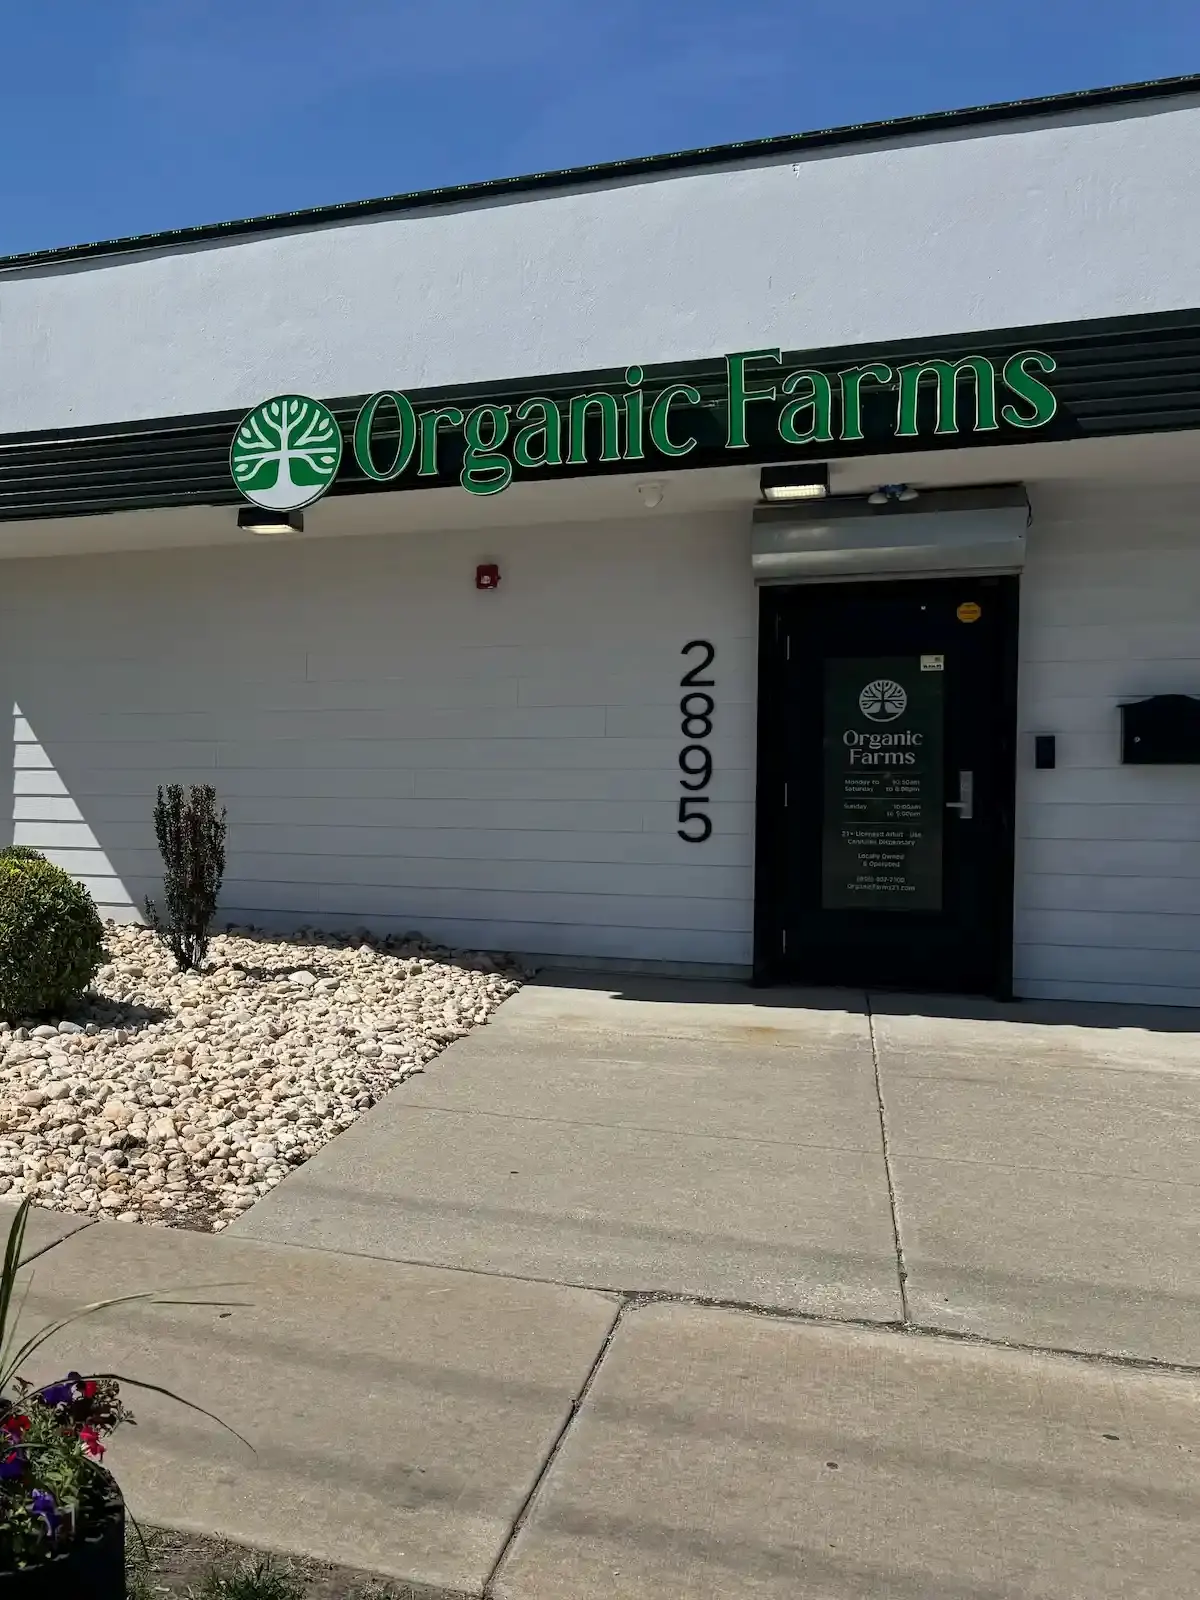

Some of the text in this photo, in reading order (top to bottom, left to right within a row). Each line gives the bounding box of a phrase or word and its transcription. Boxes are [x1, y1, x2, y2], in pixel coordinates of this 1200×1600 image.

[352, 346, 1059, 496] Organic Farms
[677, 639, 716, 843] 2895
[842, 729, 923, 750] Organic
[849, 748, 916, 765] Farms
